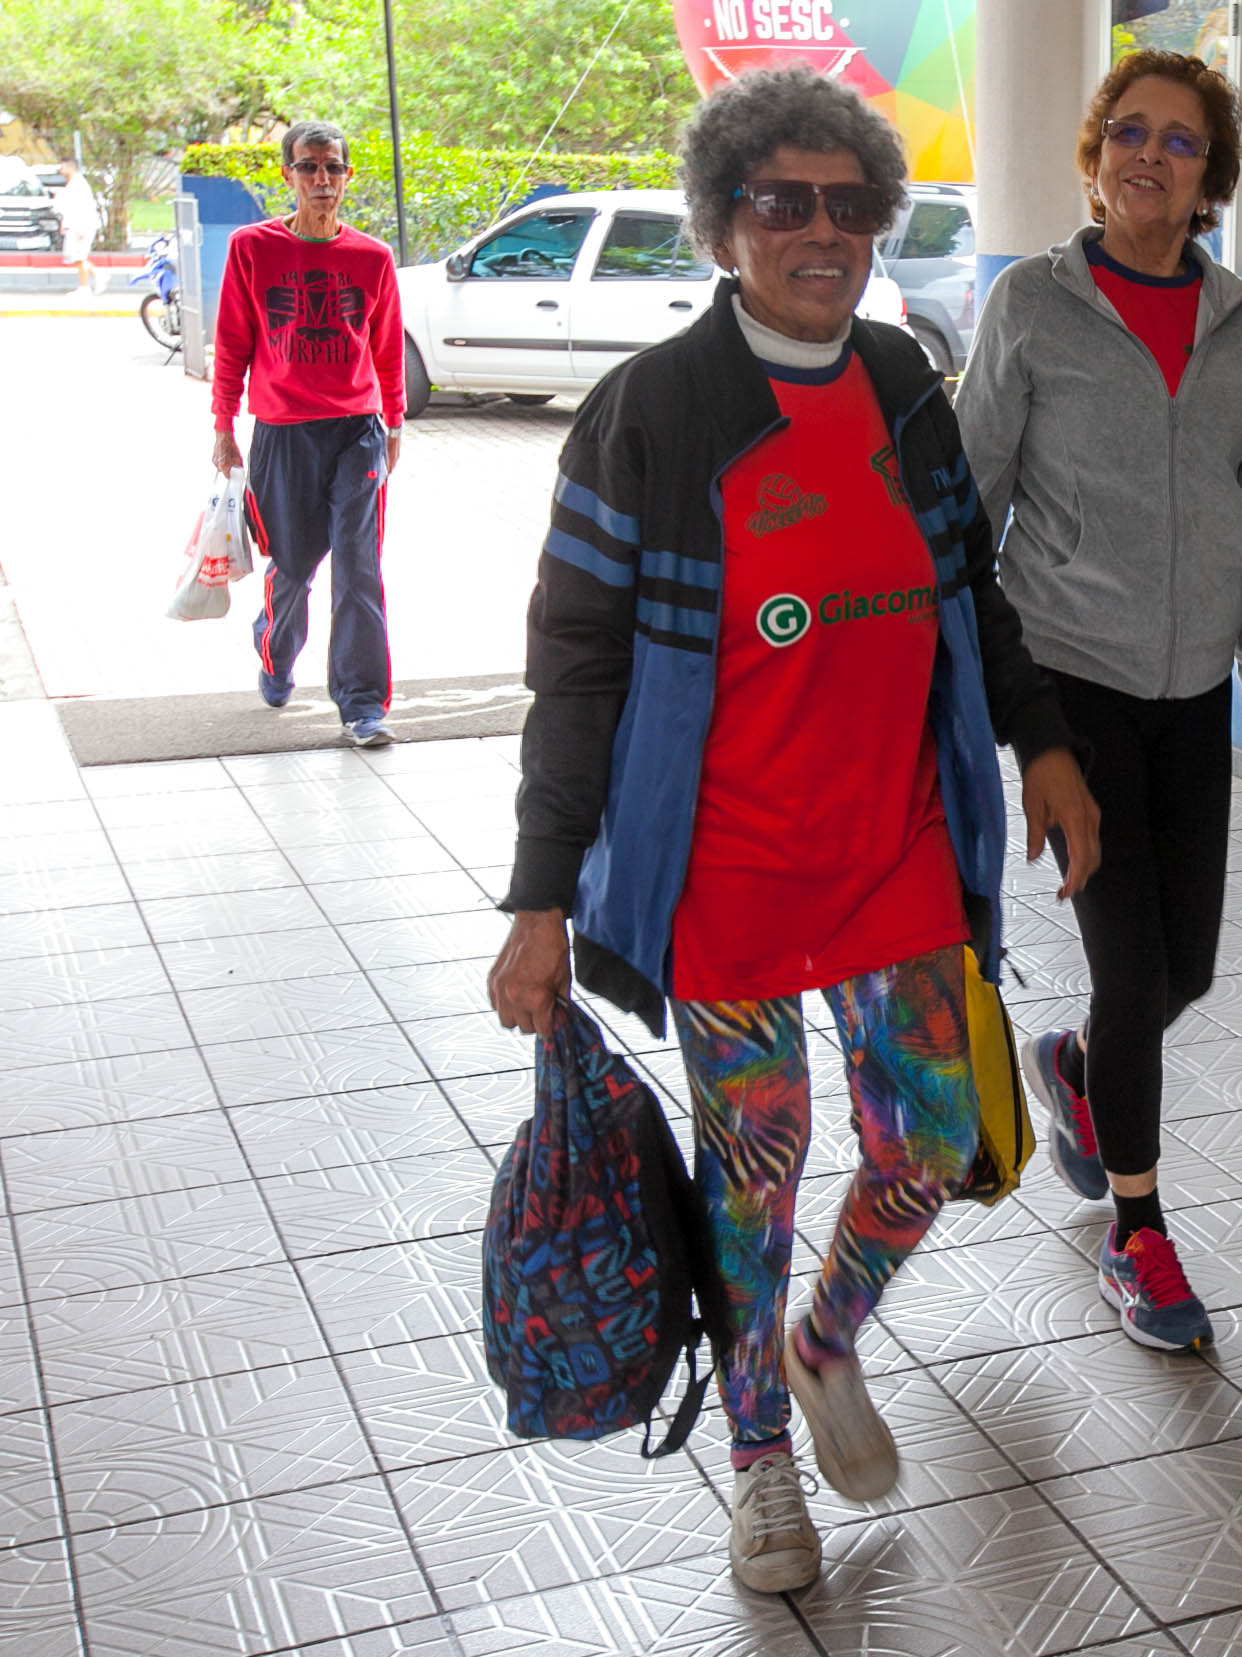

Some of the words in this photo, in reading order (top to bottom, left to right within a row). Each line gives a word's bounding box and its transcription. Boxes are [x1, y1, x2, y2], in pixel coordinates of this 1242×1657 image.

[713, 0, 749, 40] NO
[752, 0, 834, 40] SESC
[818, 586, 939, 625] Giacom
